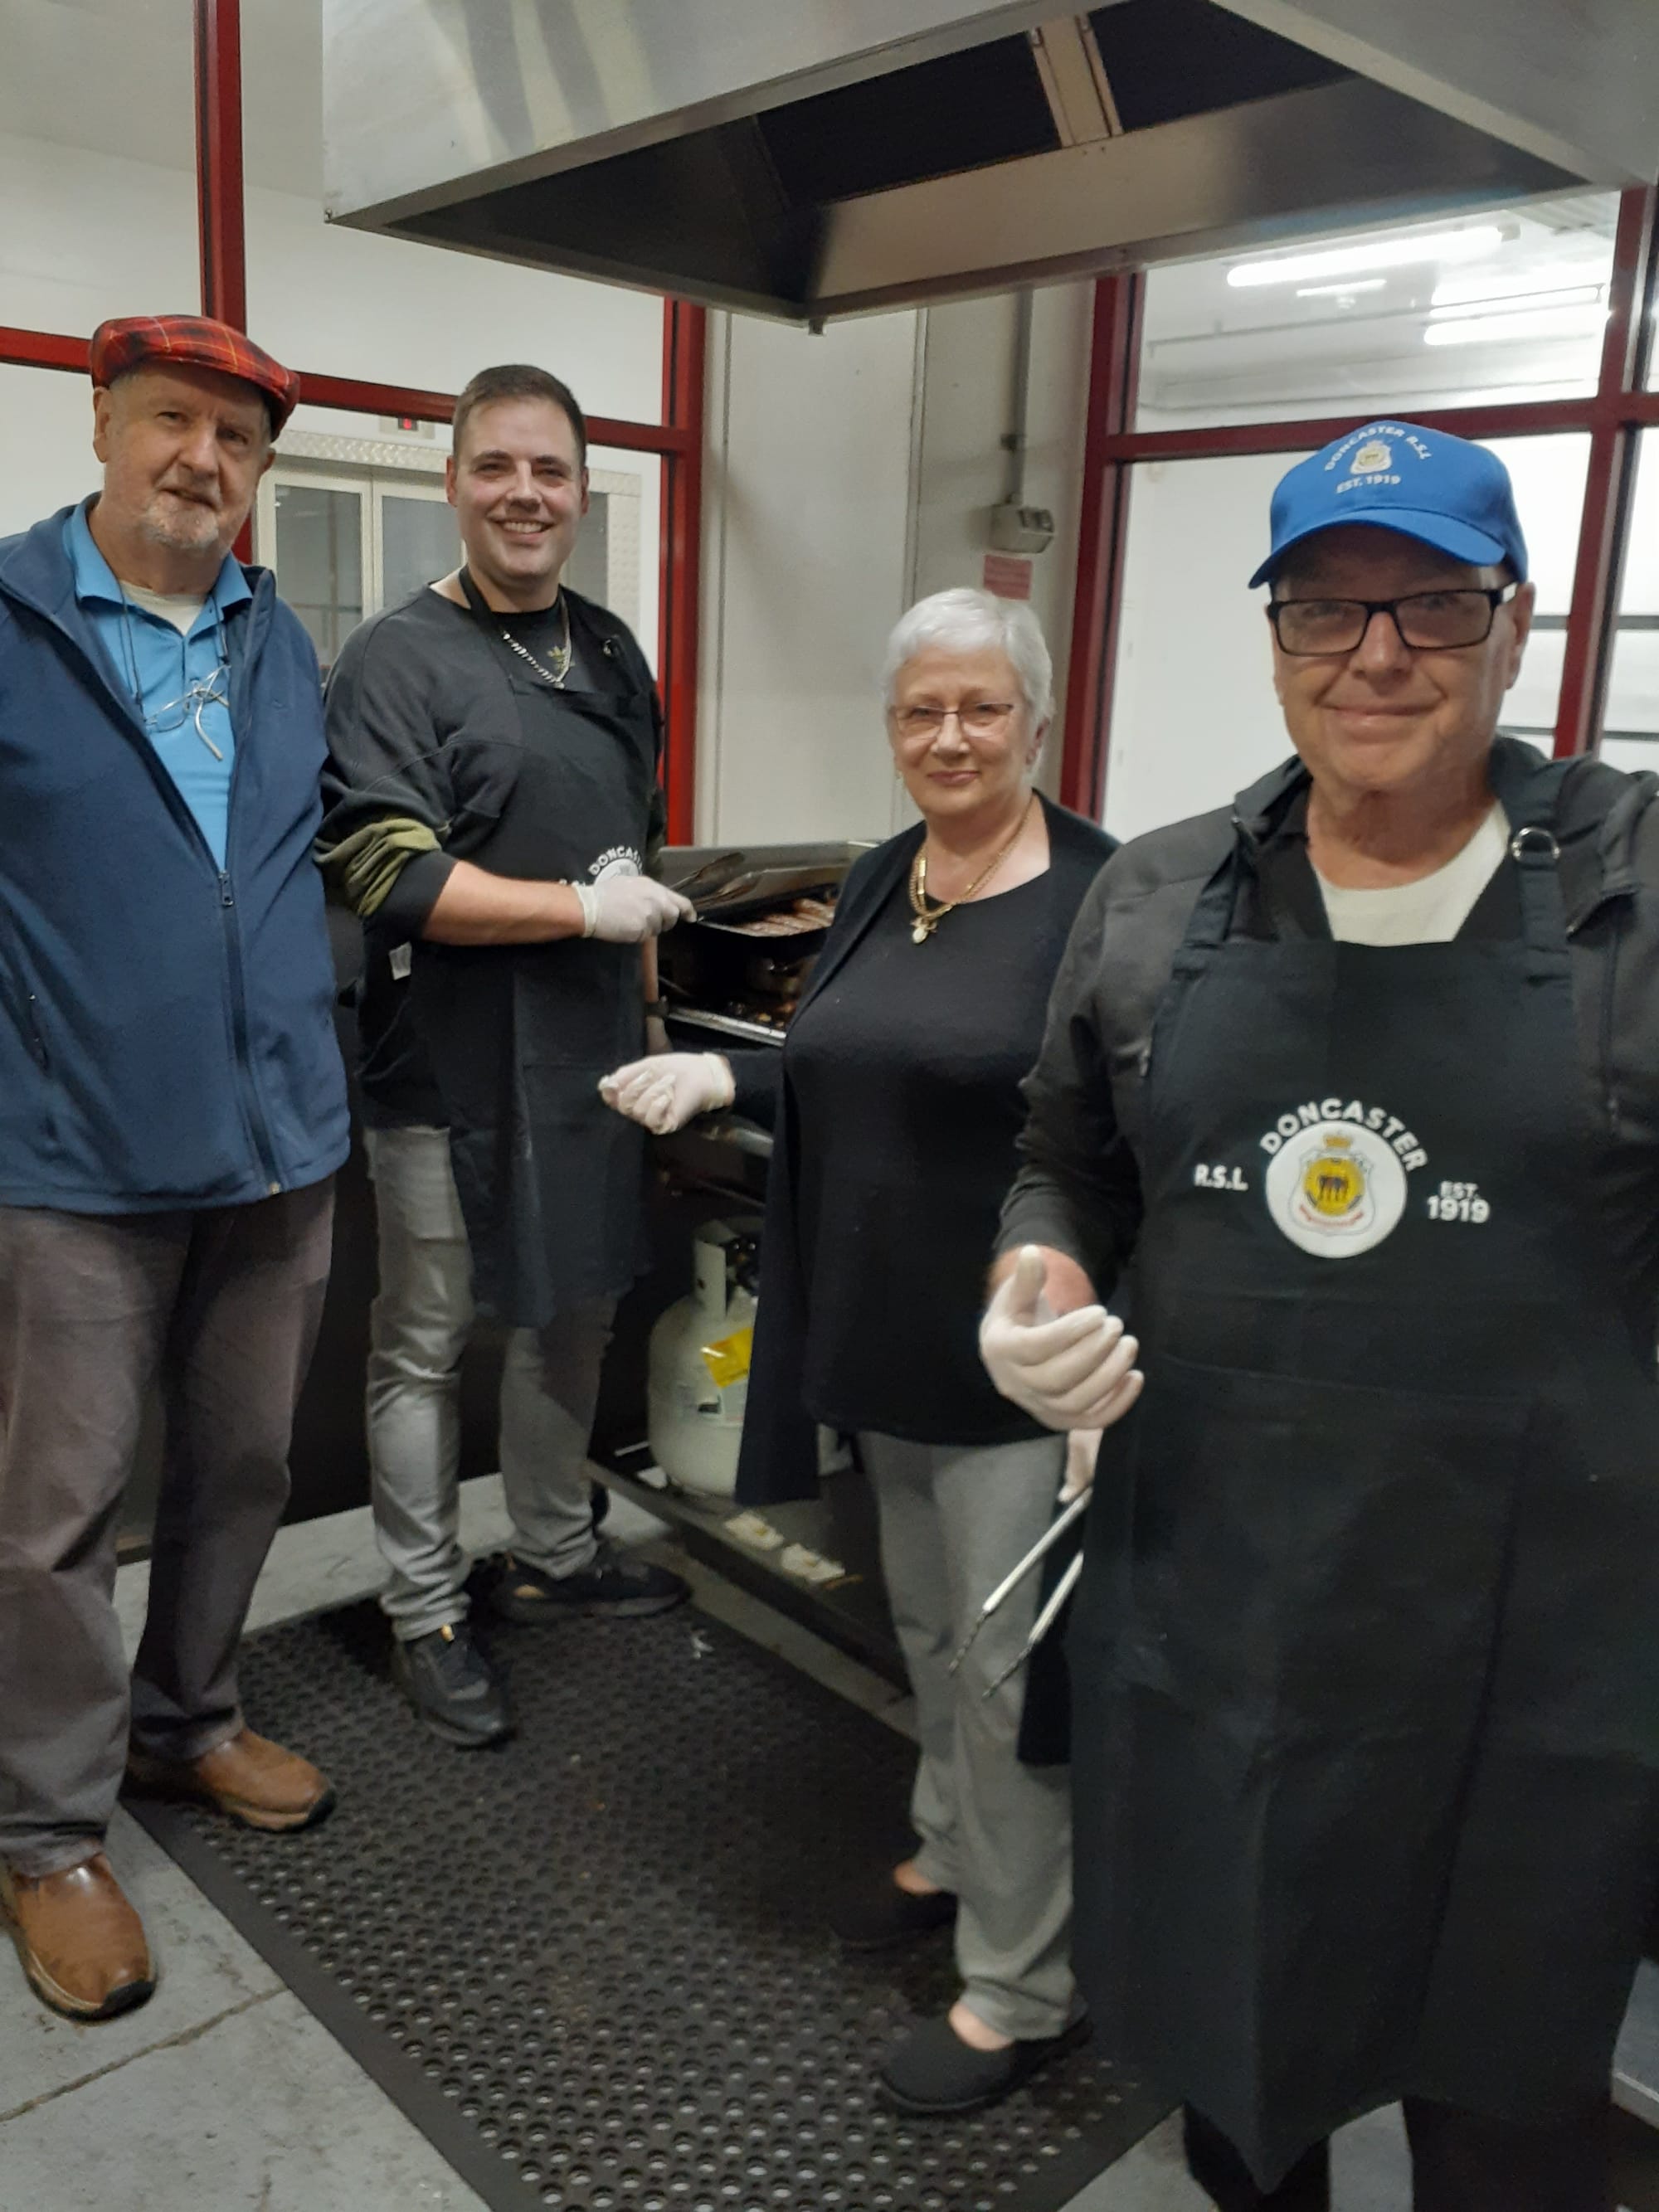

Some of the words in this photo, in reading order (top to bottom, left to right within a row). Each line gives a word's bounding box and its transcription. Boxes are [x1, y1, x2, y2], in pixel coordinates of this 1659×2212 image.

[1324, 425, 1405, 471] DONCASTER
[1366, 474, 1401, 485] 1919
[1259, 1098, 1428, 1172] DONCASTER
[1427, 1194, 1491, 1223] 1919
